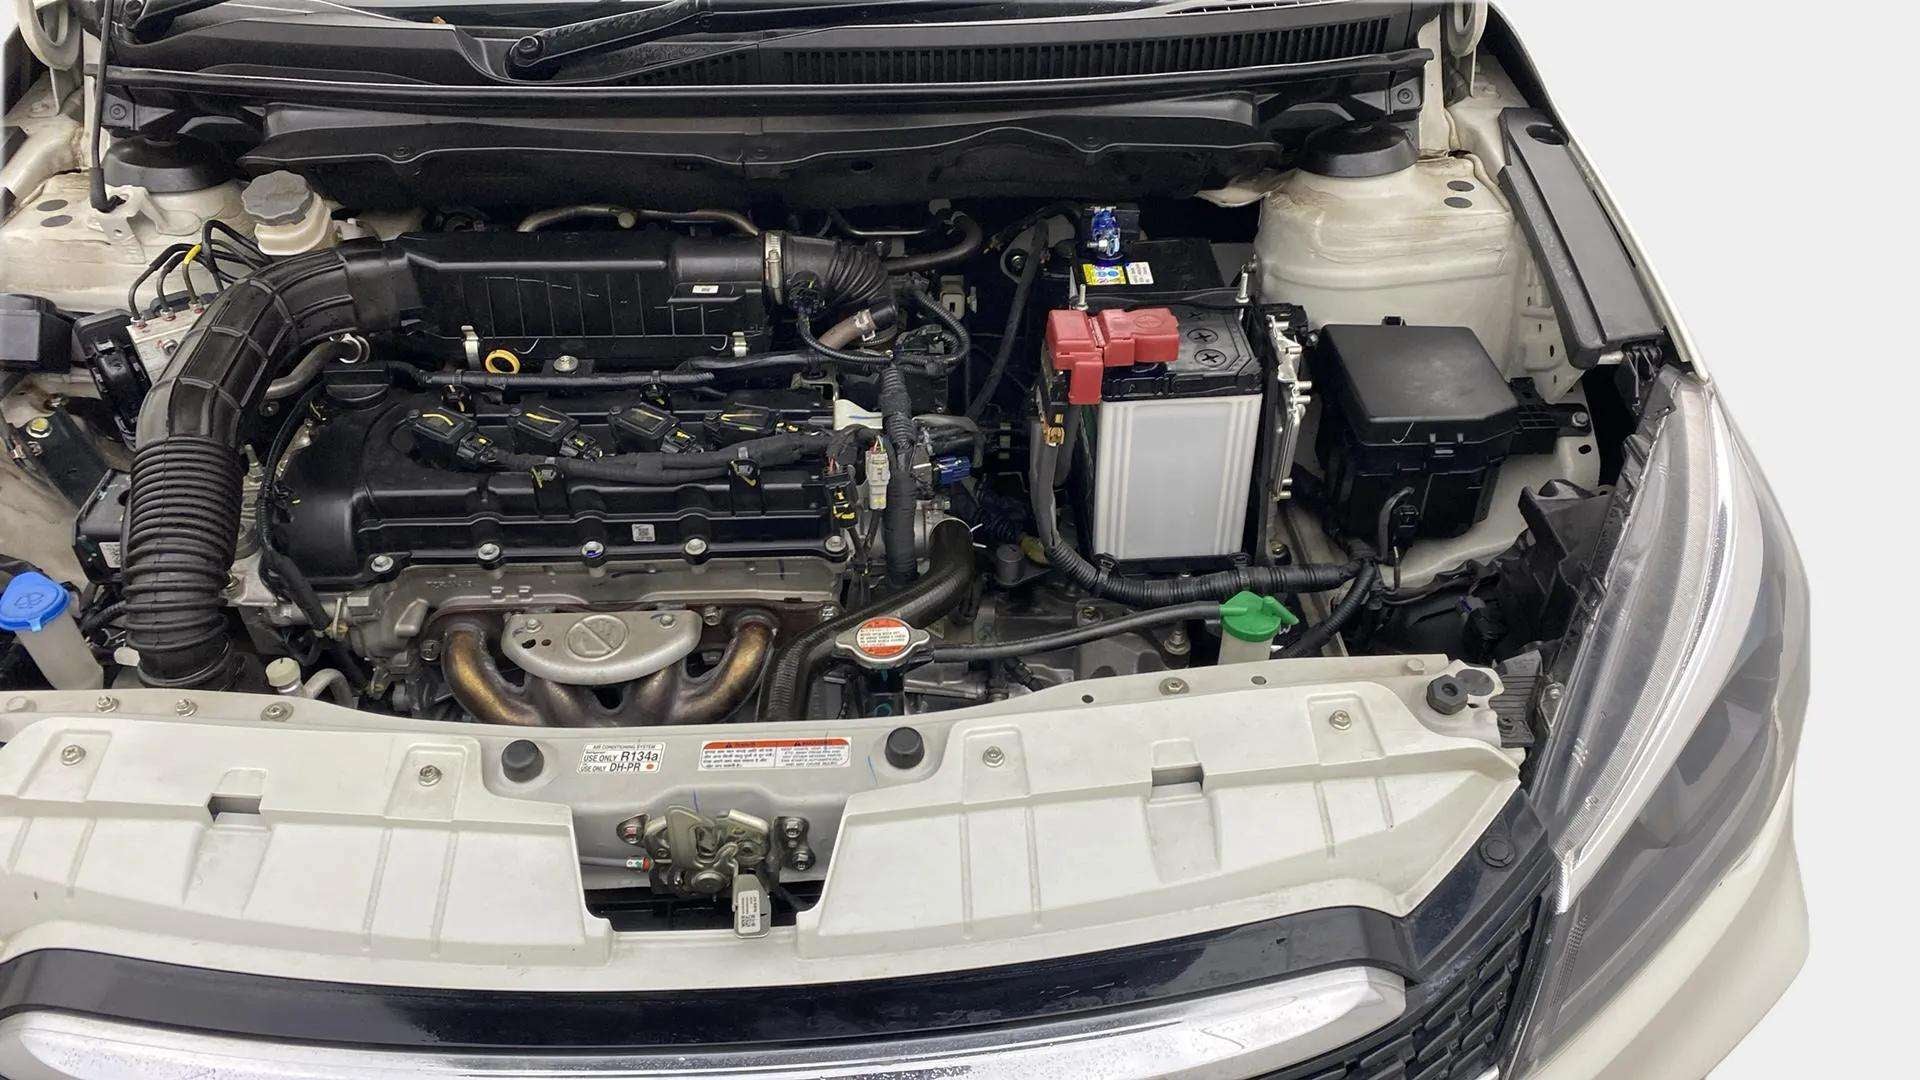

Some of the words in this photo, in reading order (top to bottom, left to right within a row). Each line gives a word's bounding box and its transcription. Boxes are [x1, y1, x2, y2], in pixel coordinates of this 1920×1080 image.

[599, 754, 618, 762] ONLY
[621, 751, 659, 761] R134a
[609, 763, 641, 772] DH-PR
